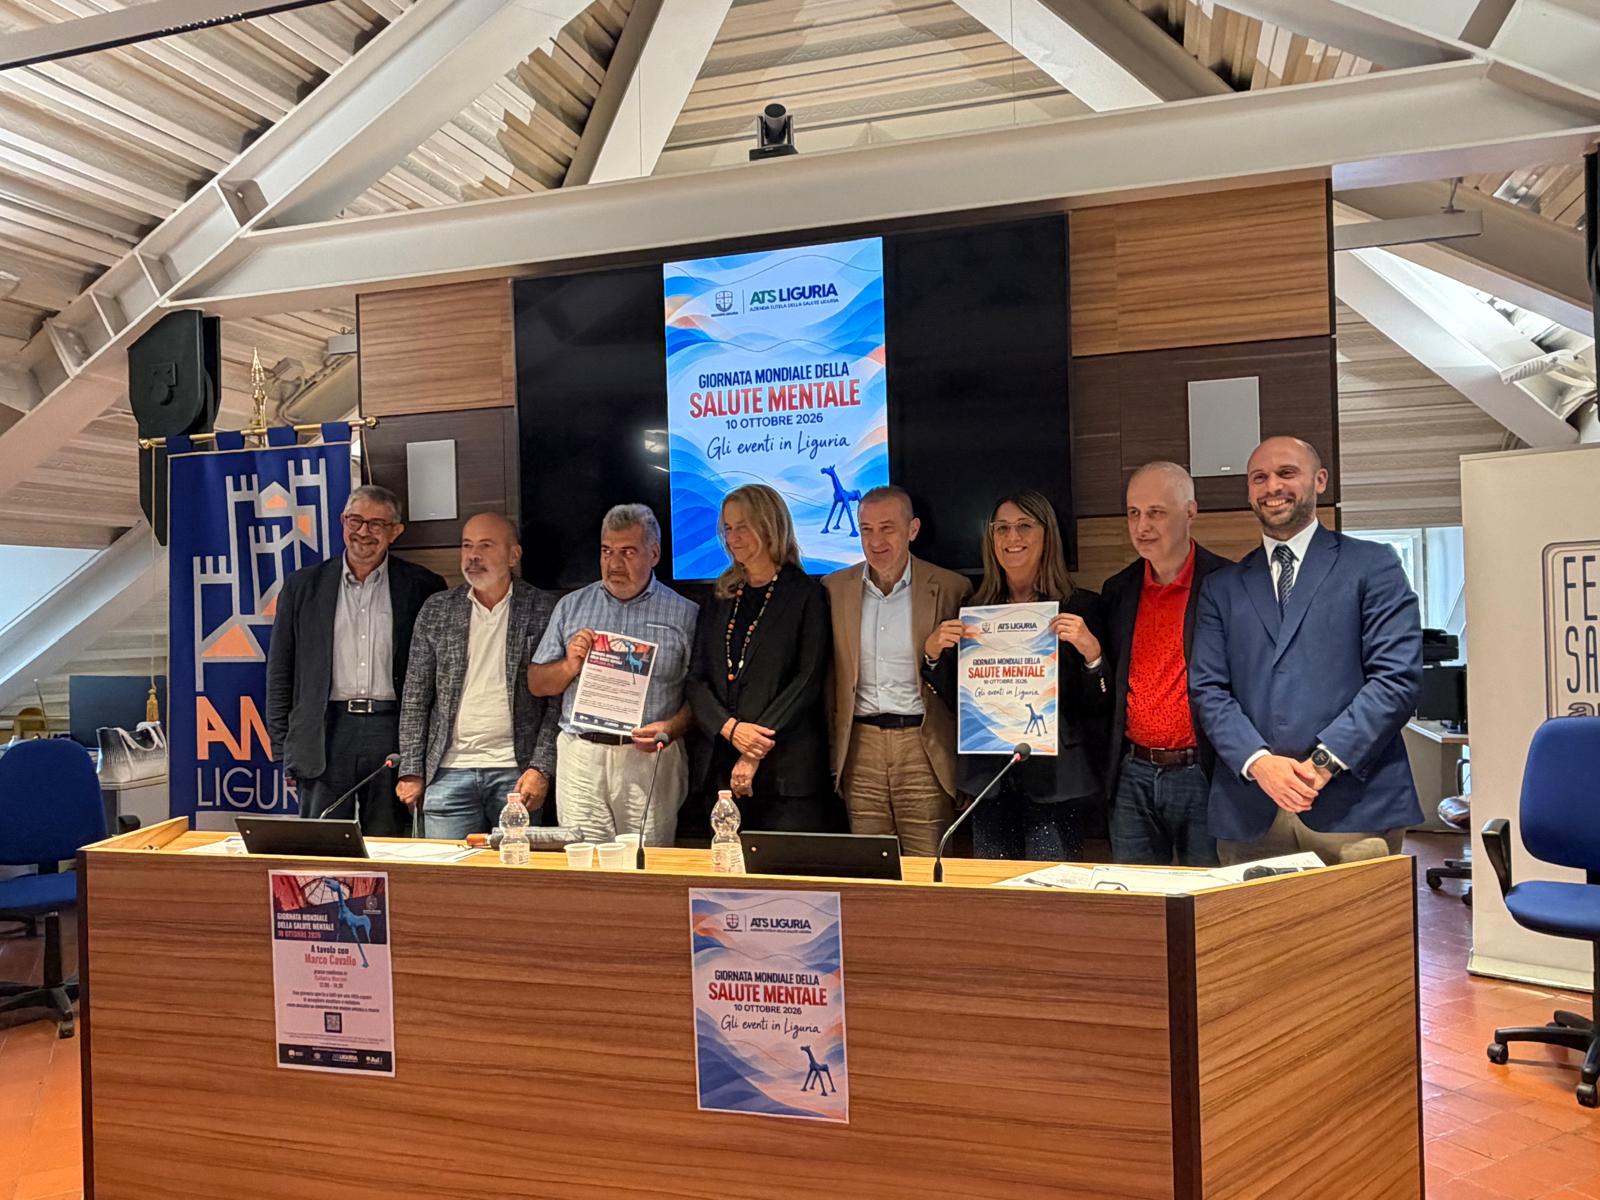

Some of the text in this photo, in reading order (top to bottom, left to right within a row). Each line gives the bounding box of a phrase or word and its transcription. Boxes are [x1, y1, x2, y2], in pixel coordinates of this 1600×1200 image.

[750, 283, 838, 305] ATS LIGURIA
[699, 361, 849, 389] GIORNATA MONDIALE DELLA
[689, 379, 861, 419] SALUTE MENTALE
[726, 412, 824, 430] 10 OTTOBRE 2026
[707, 430, 850, 460] Gli eventi in Liguria
[998, 622, 1037, 630] ATS LIGURIA
[997, 657, 1023, 665] MONDIALE
[968, 665, 1045, 679] SALUTE MENTALE
[1015, 686, 1040, 700] Liguria
[750, 917, 812, 930] ATS LIGURIA
[311, 944, 349, 955] A tavola con
[304, 953, 356, 966] Marco Cavallo
[714, 969, 820, 986] GIORNATA MONDIALE DELLA
[708, 982, 828, 1006] SALUTE MENTALE
[734, 1004, 802, 1015] 10 OTTOBRE 2026
[720, 1014, 821, 1039] Gli eventi in Liguria
